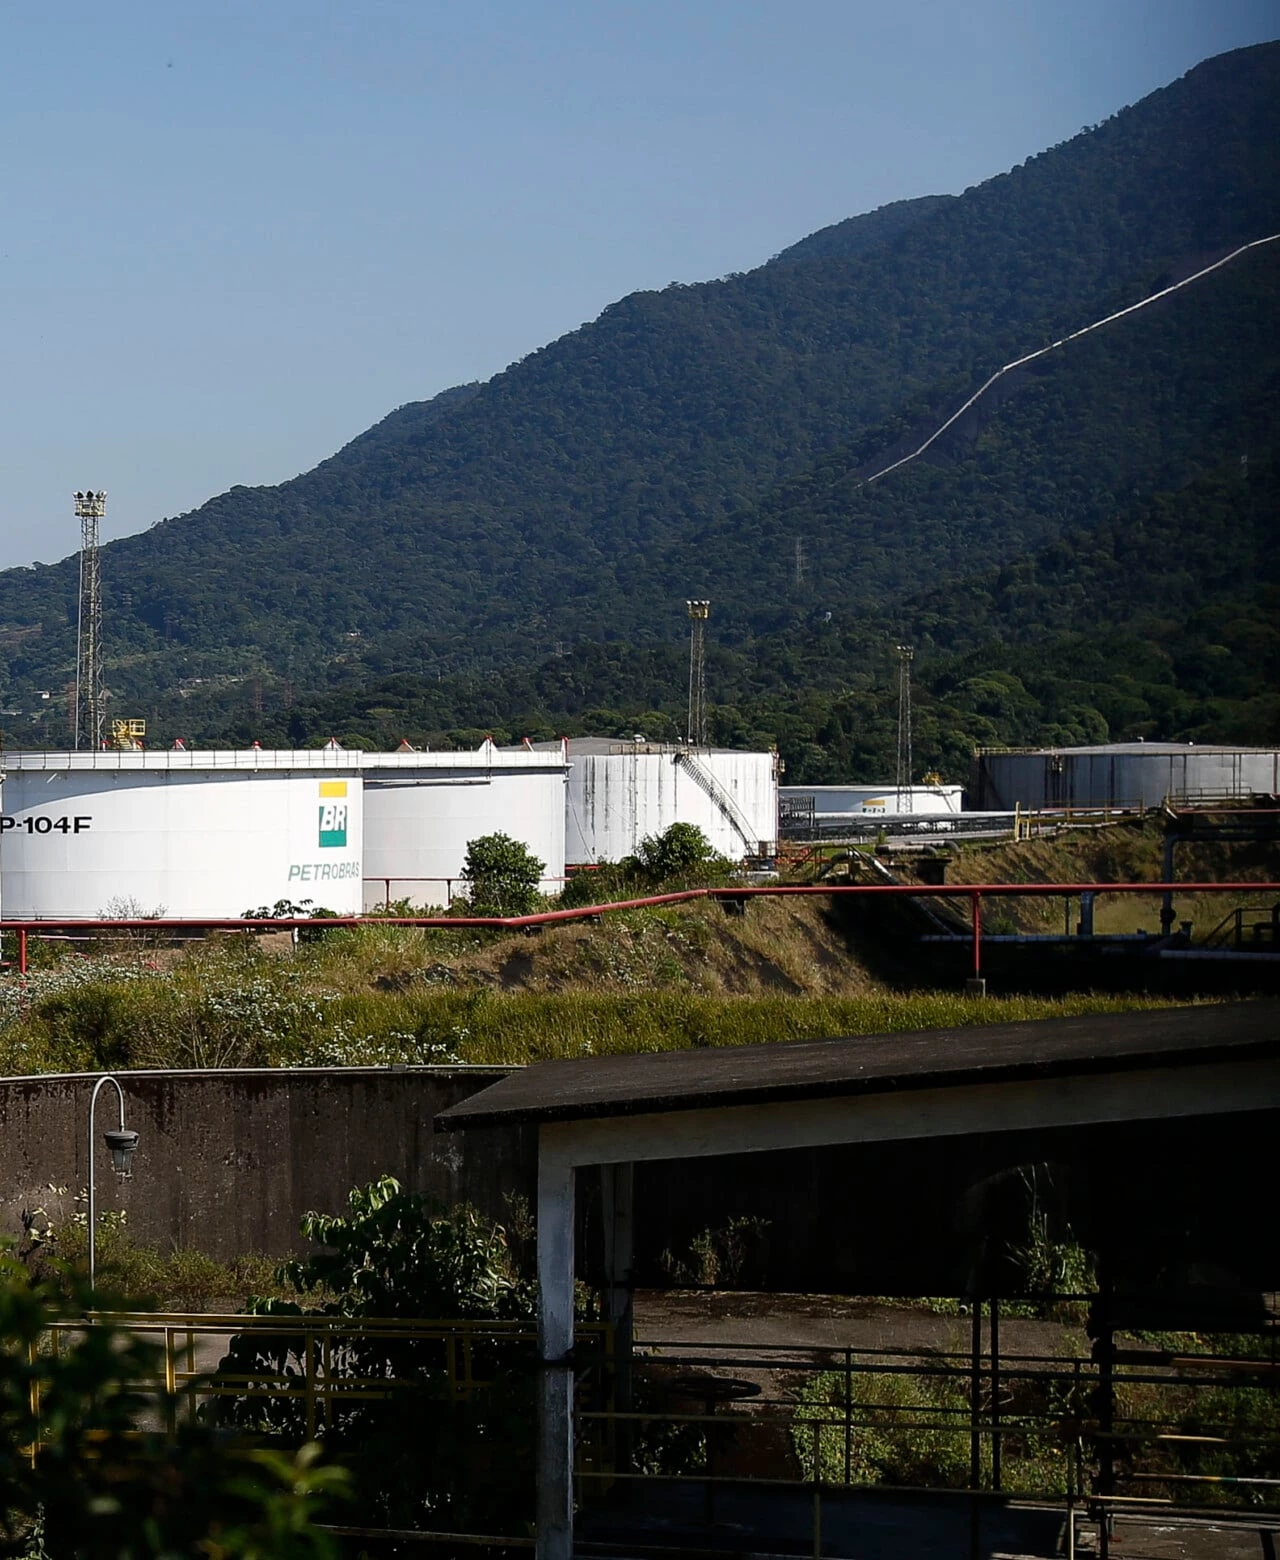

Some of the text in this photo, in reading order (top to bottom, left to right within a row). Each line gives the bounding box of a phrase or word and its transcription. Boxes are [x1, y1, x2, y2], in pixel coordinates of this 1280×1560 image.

[0, 816, 93, 834] P-104F
[320, 805, 346, 831] BR
[288, 861, 360, 881] PETROBRAS
